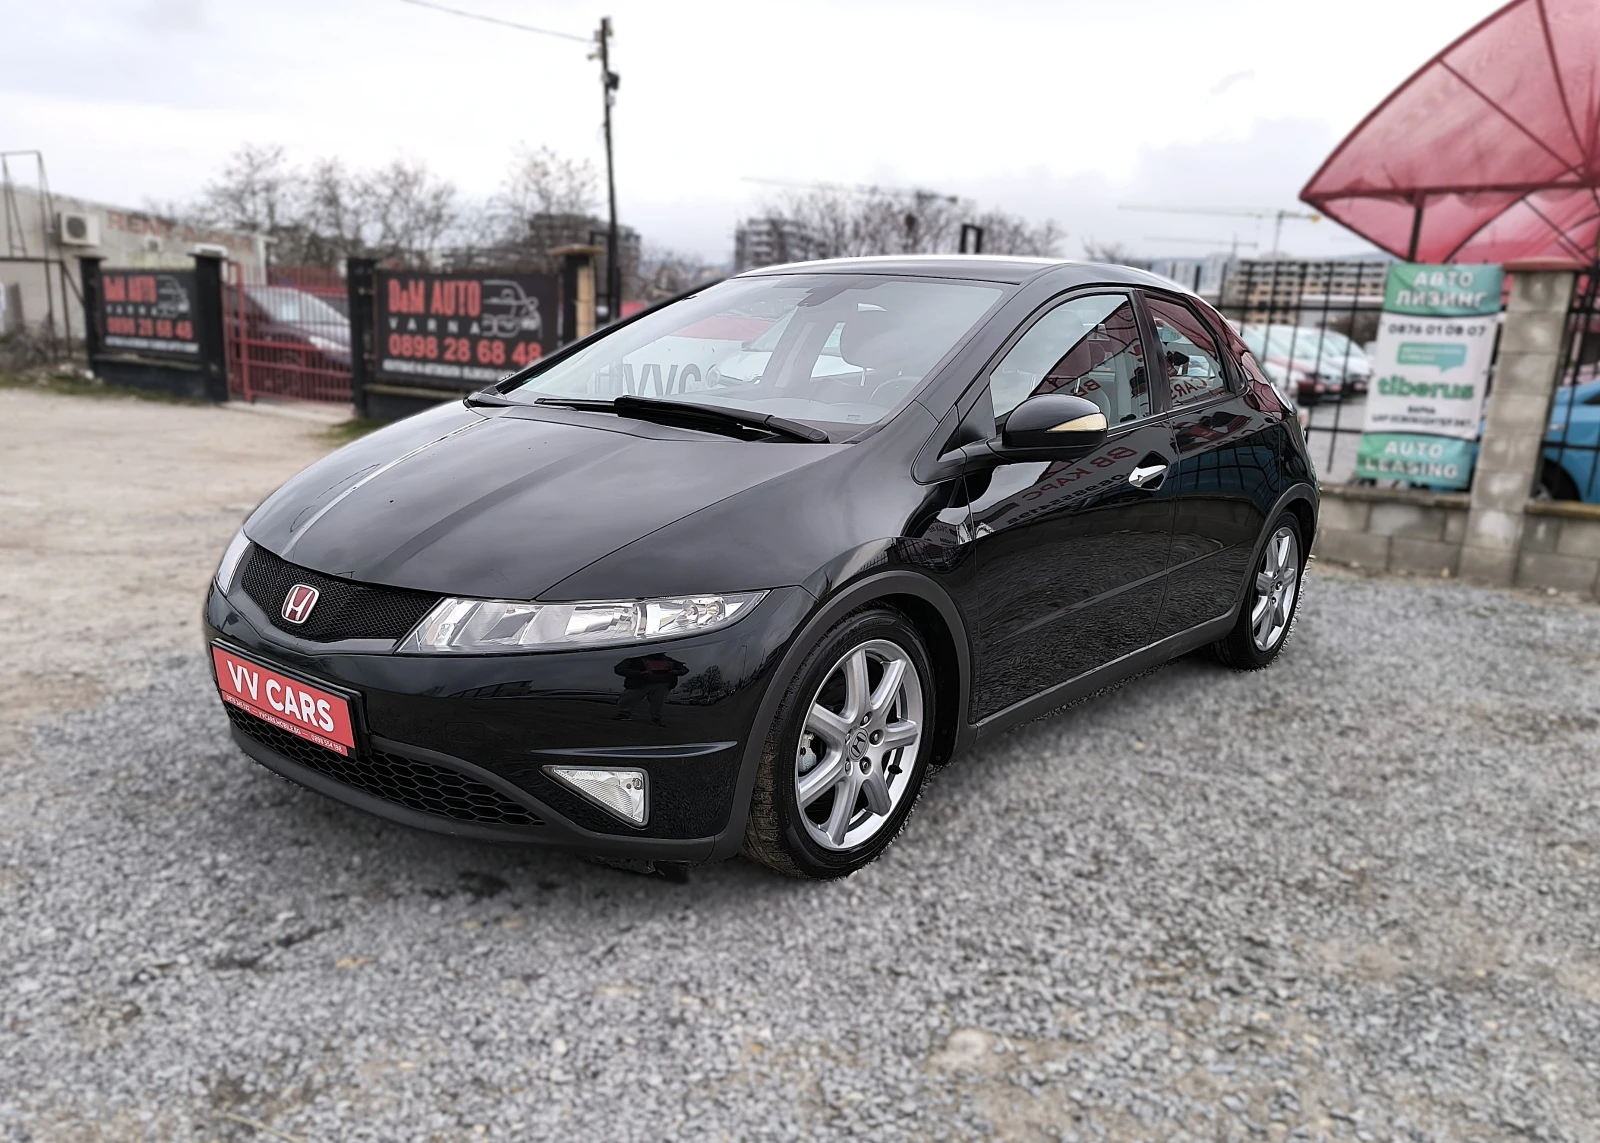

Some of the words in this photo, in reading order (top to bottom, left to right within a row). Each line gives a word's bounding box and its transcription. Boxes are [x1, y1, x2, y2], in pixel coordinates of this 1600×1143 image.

[1413, 271, 1474, 288] АВТО
[430, 279, 481, 318] AUTO
[1394, 289, 1488, 309] ЛИЗИНГ
[388, 317, 482, 334] VARNA
[1467, 325, 1487, 337] 07
[388, 333, 438, 360] 0898
[443, 337, 471, 362] 28
[476, 339, 506, 366] 68
[511, 341, 543, 367] 48
[1377, 374, 1476, 400] tiberus
[1384, 440, 1444, 459] AUTO
[1365, 457, 1459, 479] LEASING
[226, 660, 259, 701] VV
[265, 679, 335, 732] CARS
